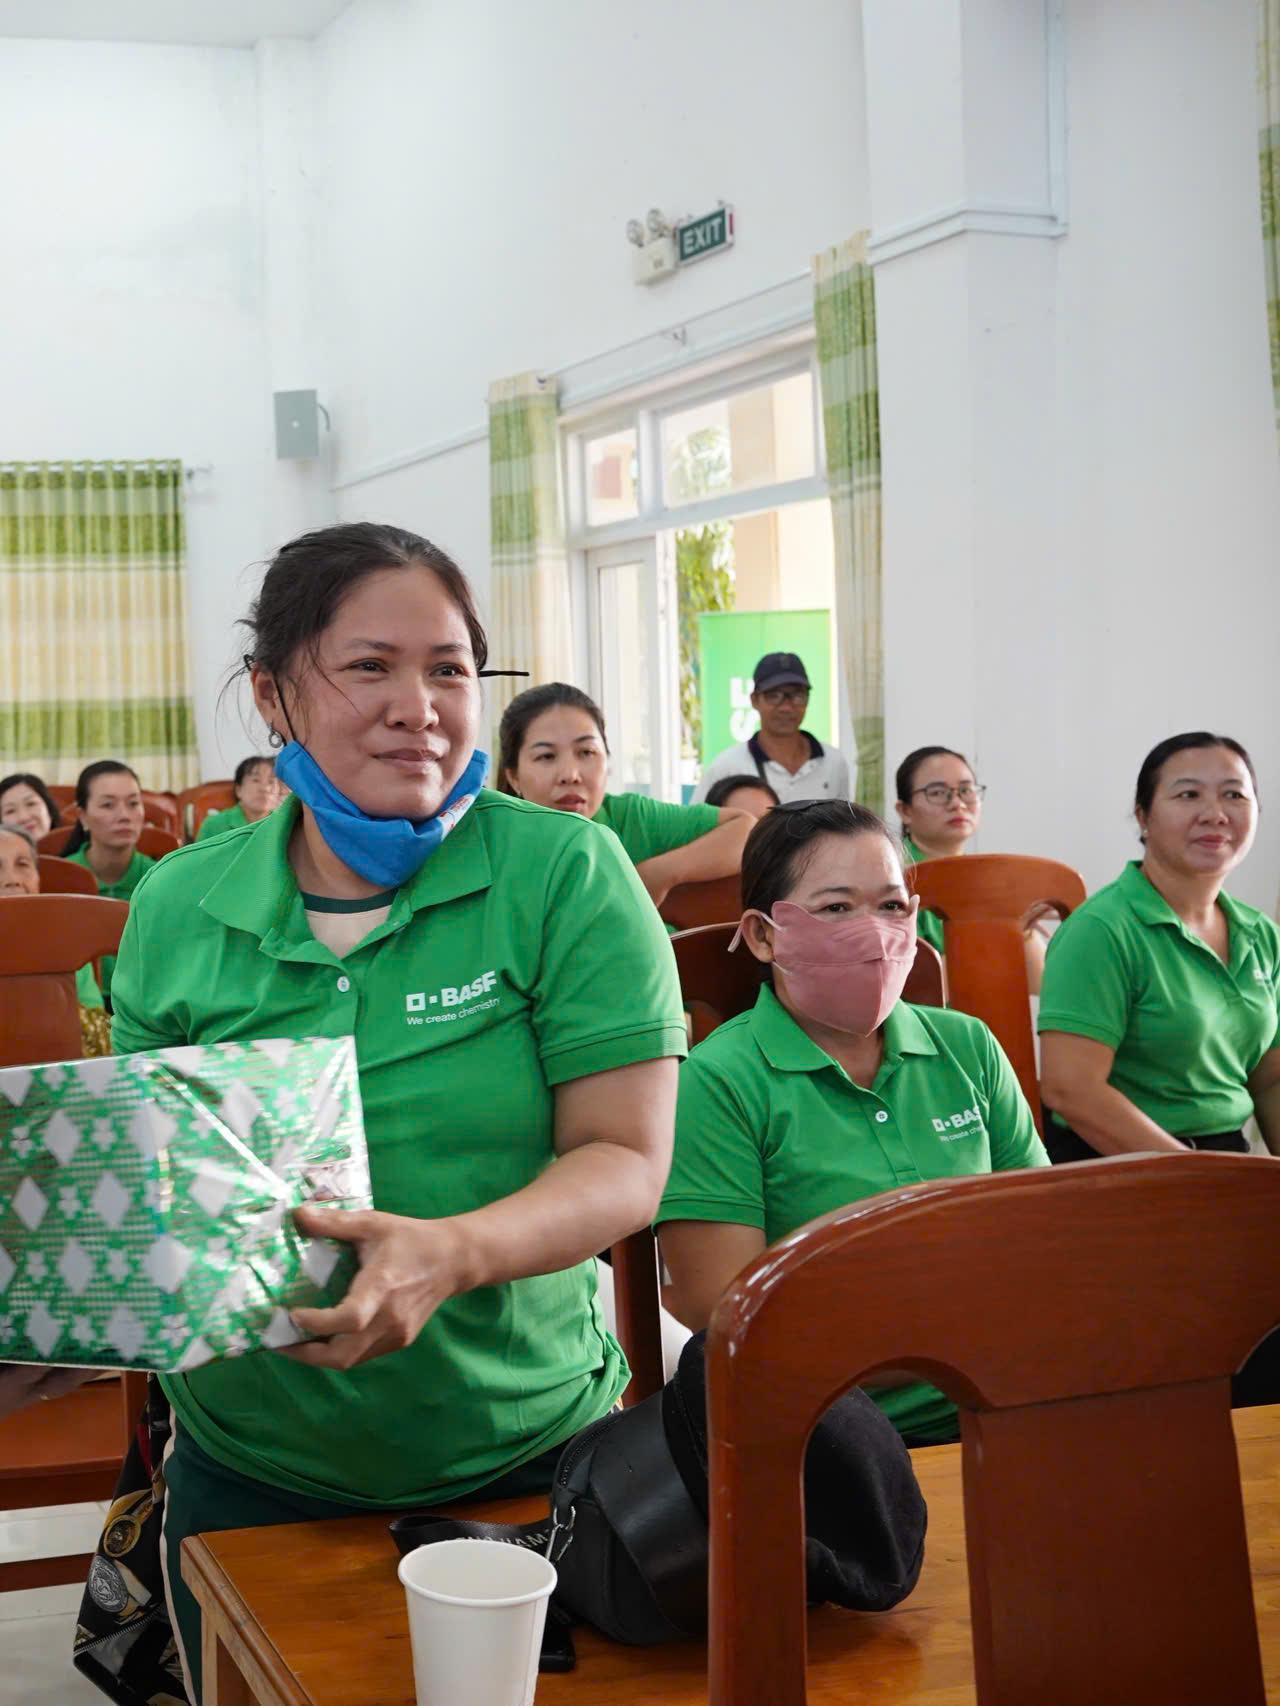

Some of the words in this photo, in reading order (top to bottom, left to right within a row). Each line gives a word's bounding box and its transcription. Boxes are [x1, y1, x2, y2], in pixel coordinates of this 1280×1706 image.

[682, 216, 723, 255] EXIT
[441, 970, 497, 1007] BASF
[406, 1016, 424, 1026] We
[425, 1012, 457, 1024] create
[949, 1106, 981, 1129] BAS
